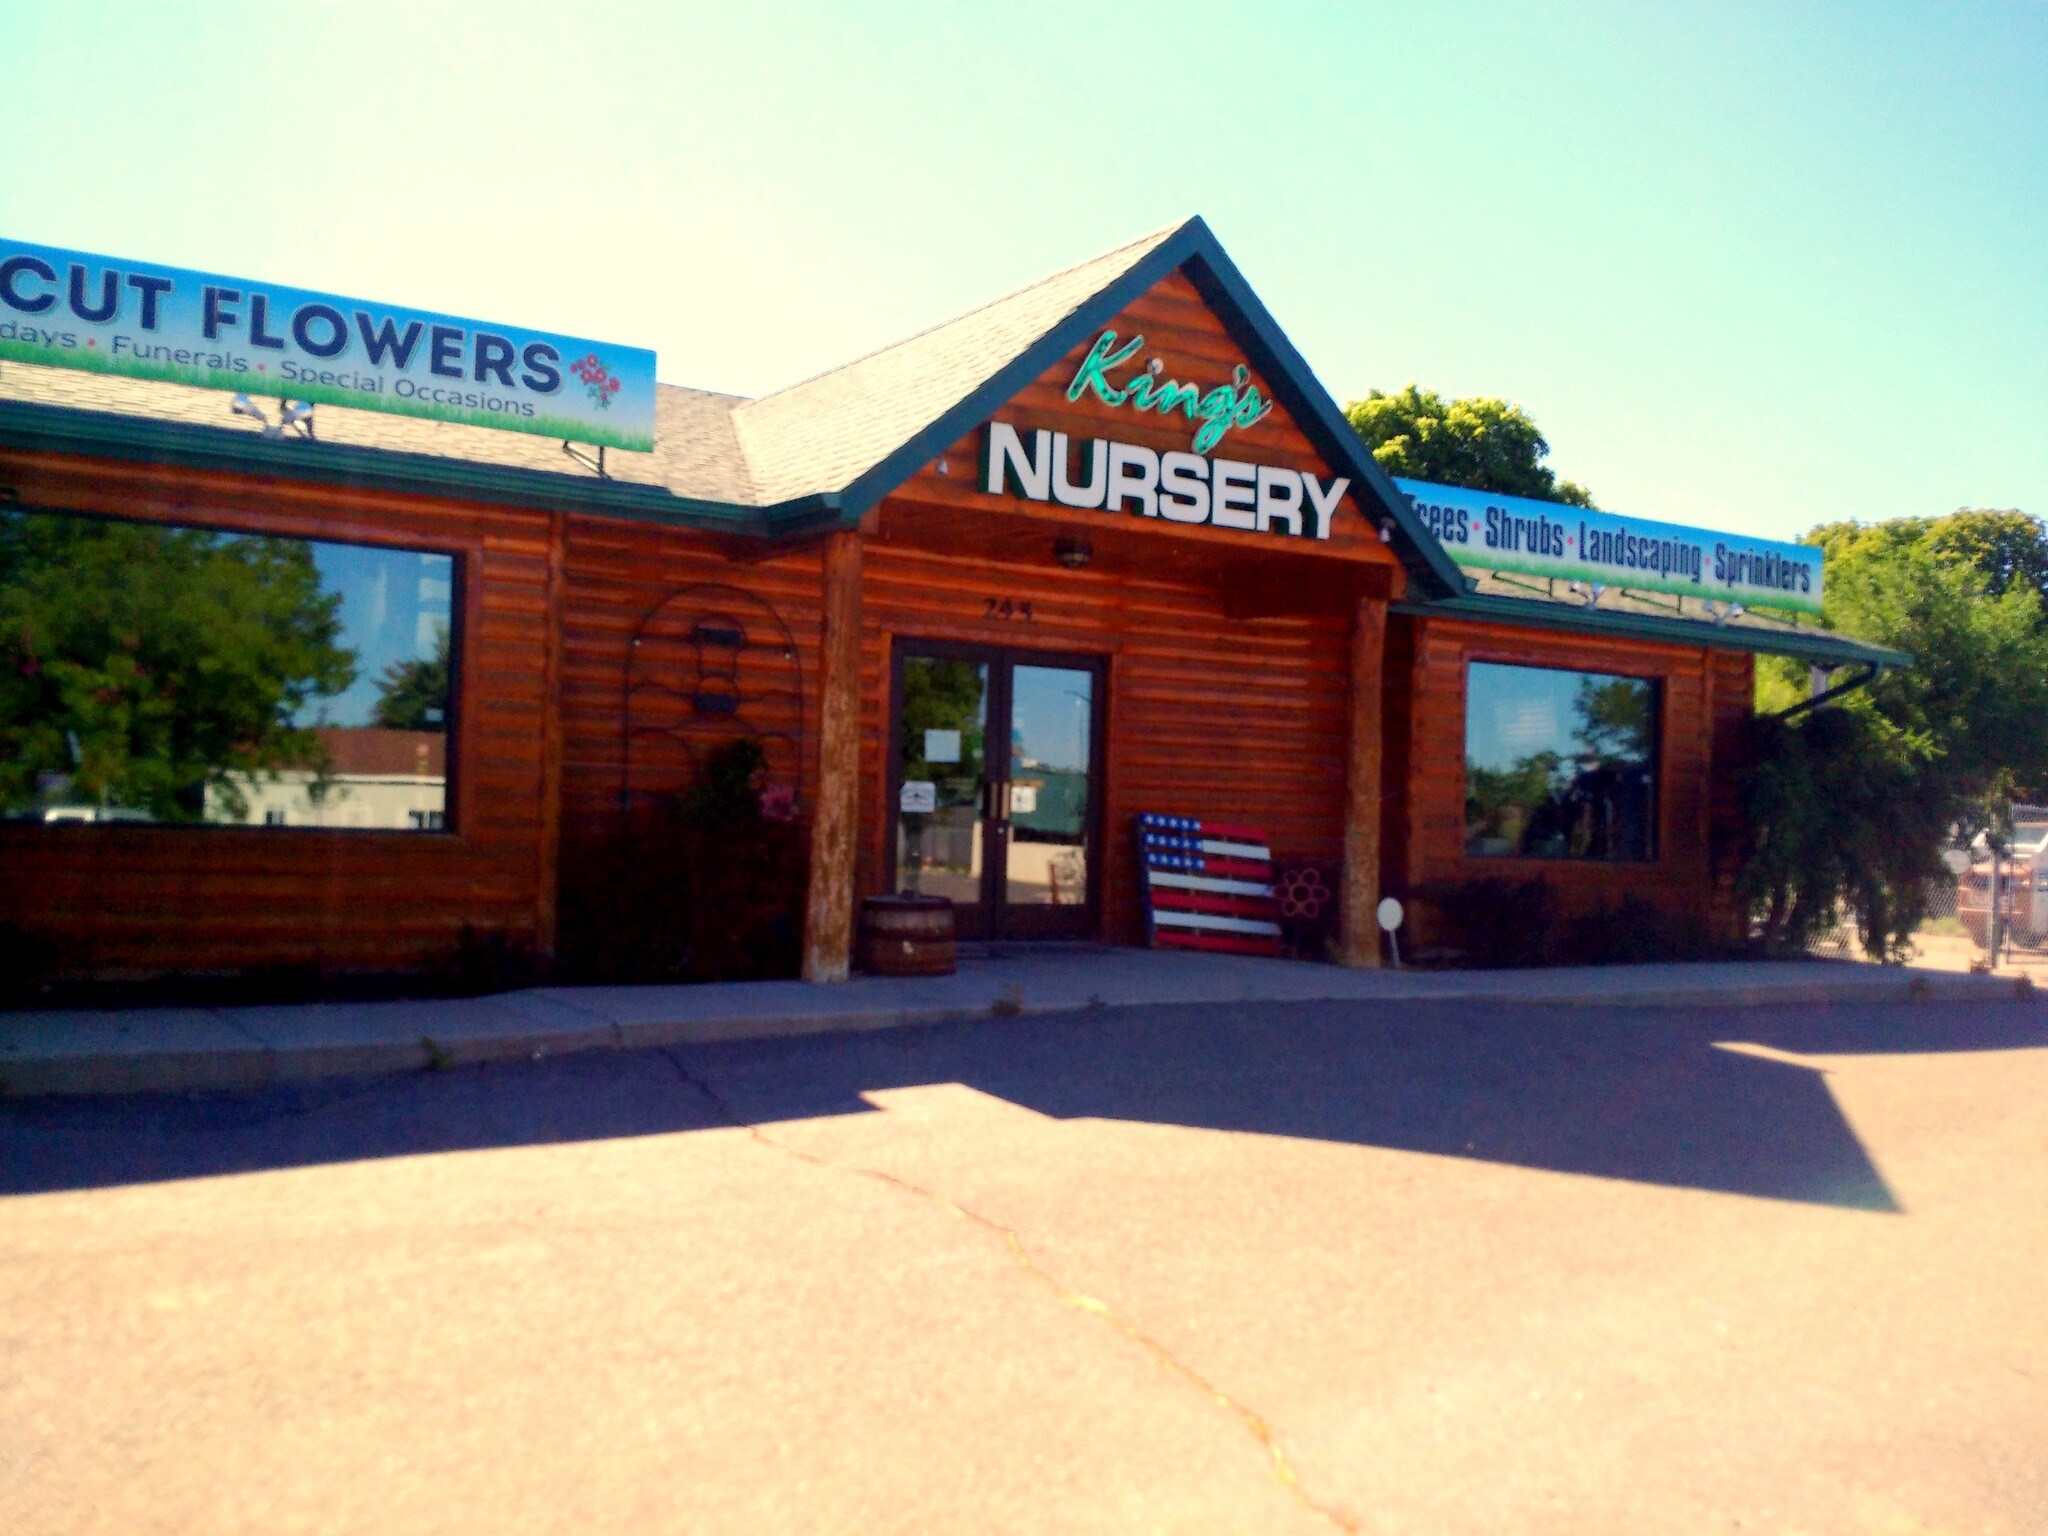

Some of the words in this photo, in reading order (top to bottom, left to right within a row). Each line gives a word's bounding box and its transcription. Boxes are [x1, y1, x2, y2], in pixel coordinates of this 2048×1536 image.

[0, 256, 172, 330] CUT
[203, 285, 562, 393] FLOWERS
[111, 334, 249, 373] Funerals
[281, 360, 383, 393] Special
[394, 378, 535, 418] Occasions
[1066, 330, 1272, 455] King's
[988, 421, 1350, 540] NURSERY
[1403, 493, 1468, 543] rees
[1485, 506, 1564, 557] Shrubs
[1579, 520, 1701, 584] Landscaping
[1714, 542, 1811, 593] Sprinklers
